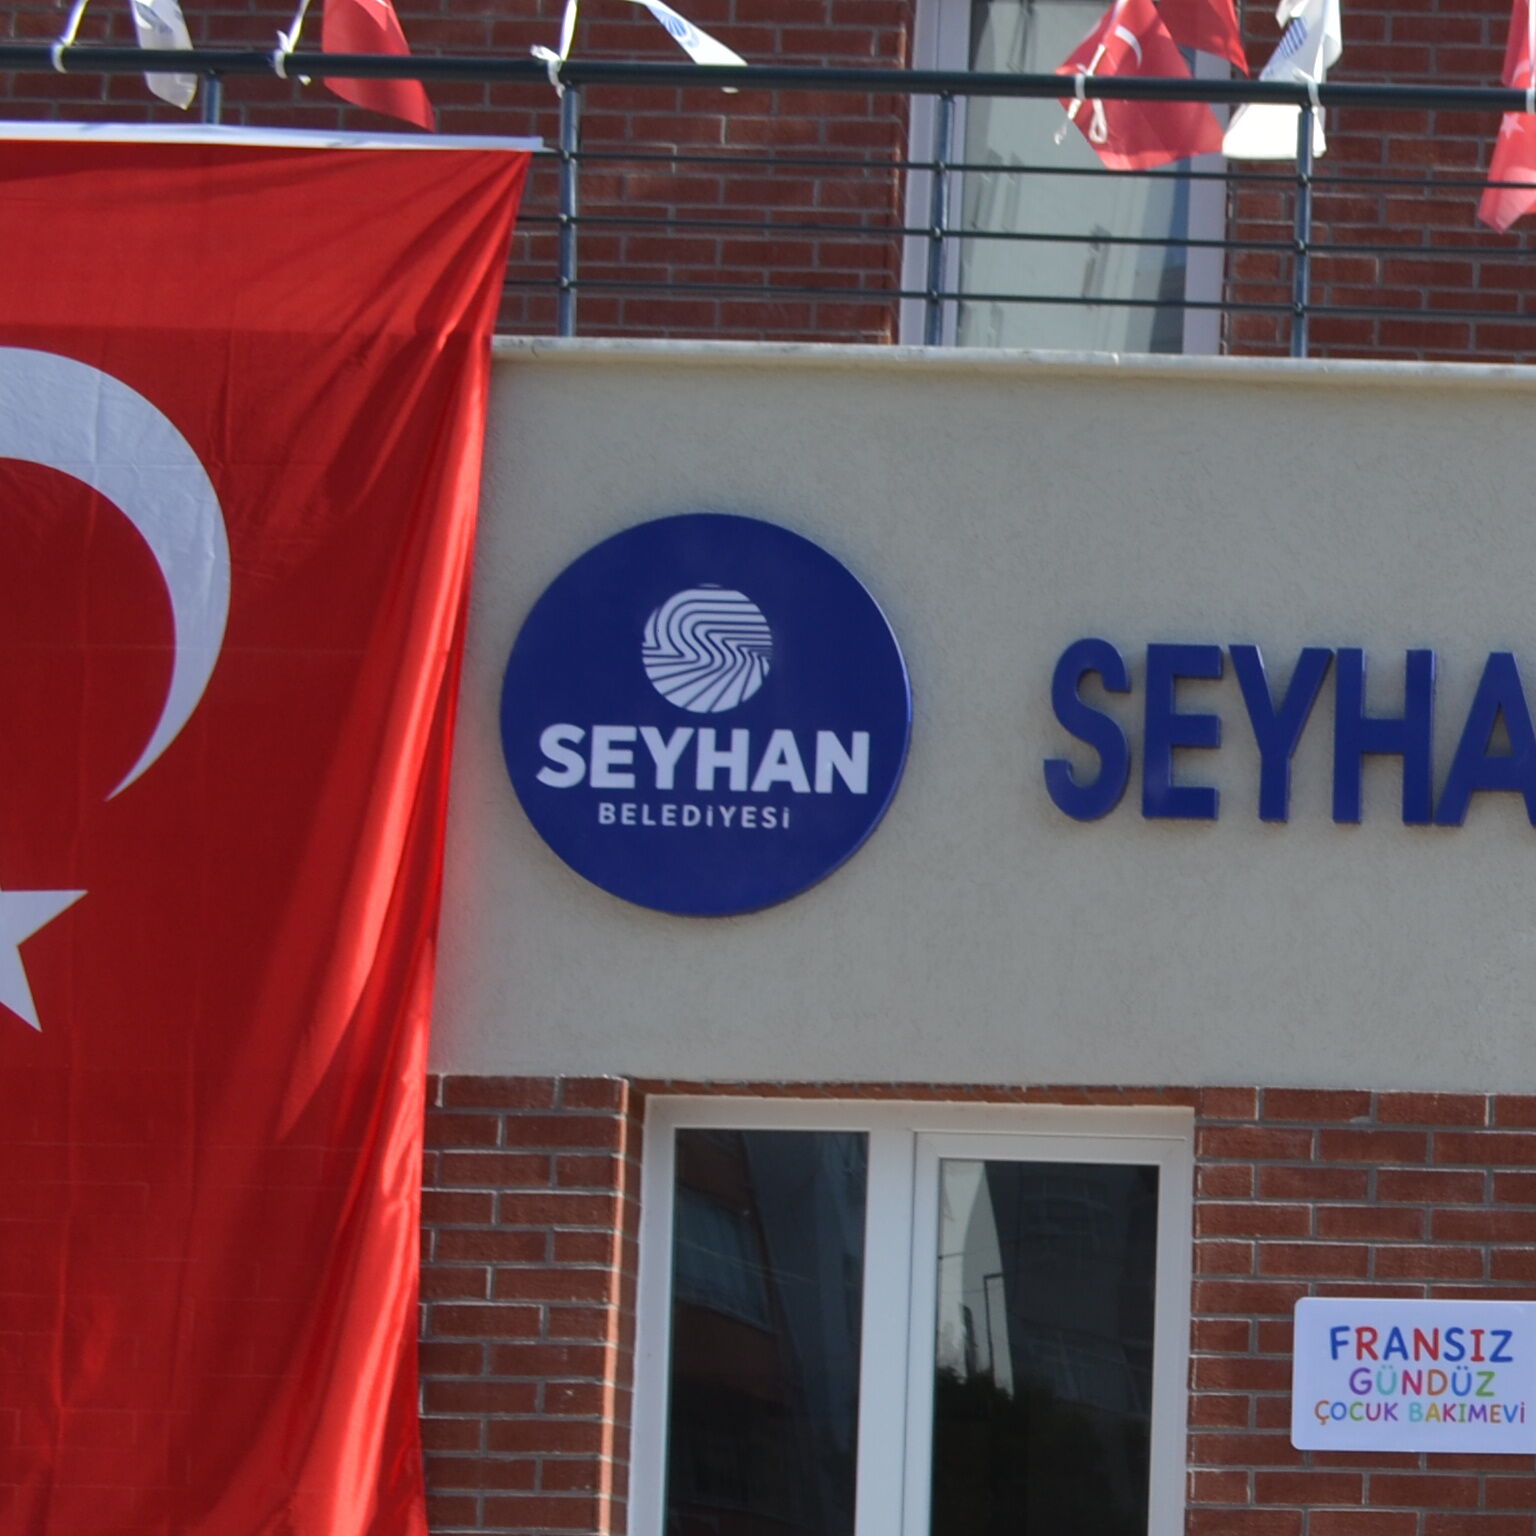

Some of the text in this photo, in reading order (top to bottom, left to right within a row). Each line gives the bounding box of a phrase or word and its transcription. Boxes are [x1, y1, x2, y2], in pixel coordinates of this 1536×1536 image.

[535, 723, 870, 795] SEYHAN
[598, 802, 791, 830] BELEDİYESİ
[1329, 1325, 1514, 1363] FRANSIZ
[1349, 1365, 1495, 1398] GÜNDÜZ
[1314, 1400, 1526, 1426] ÇOCUK BAKIMEVİ
